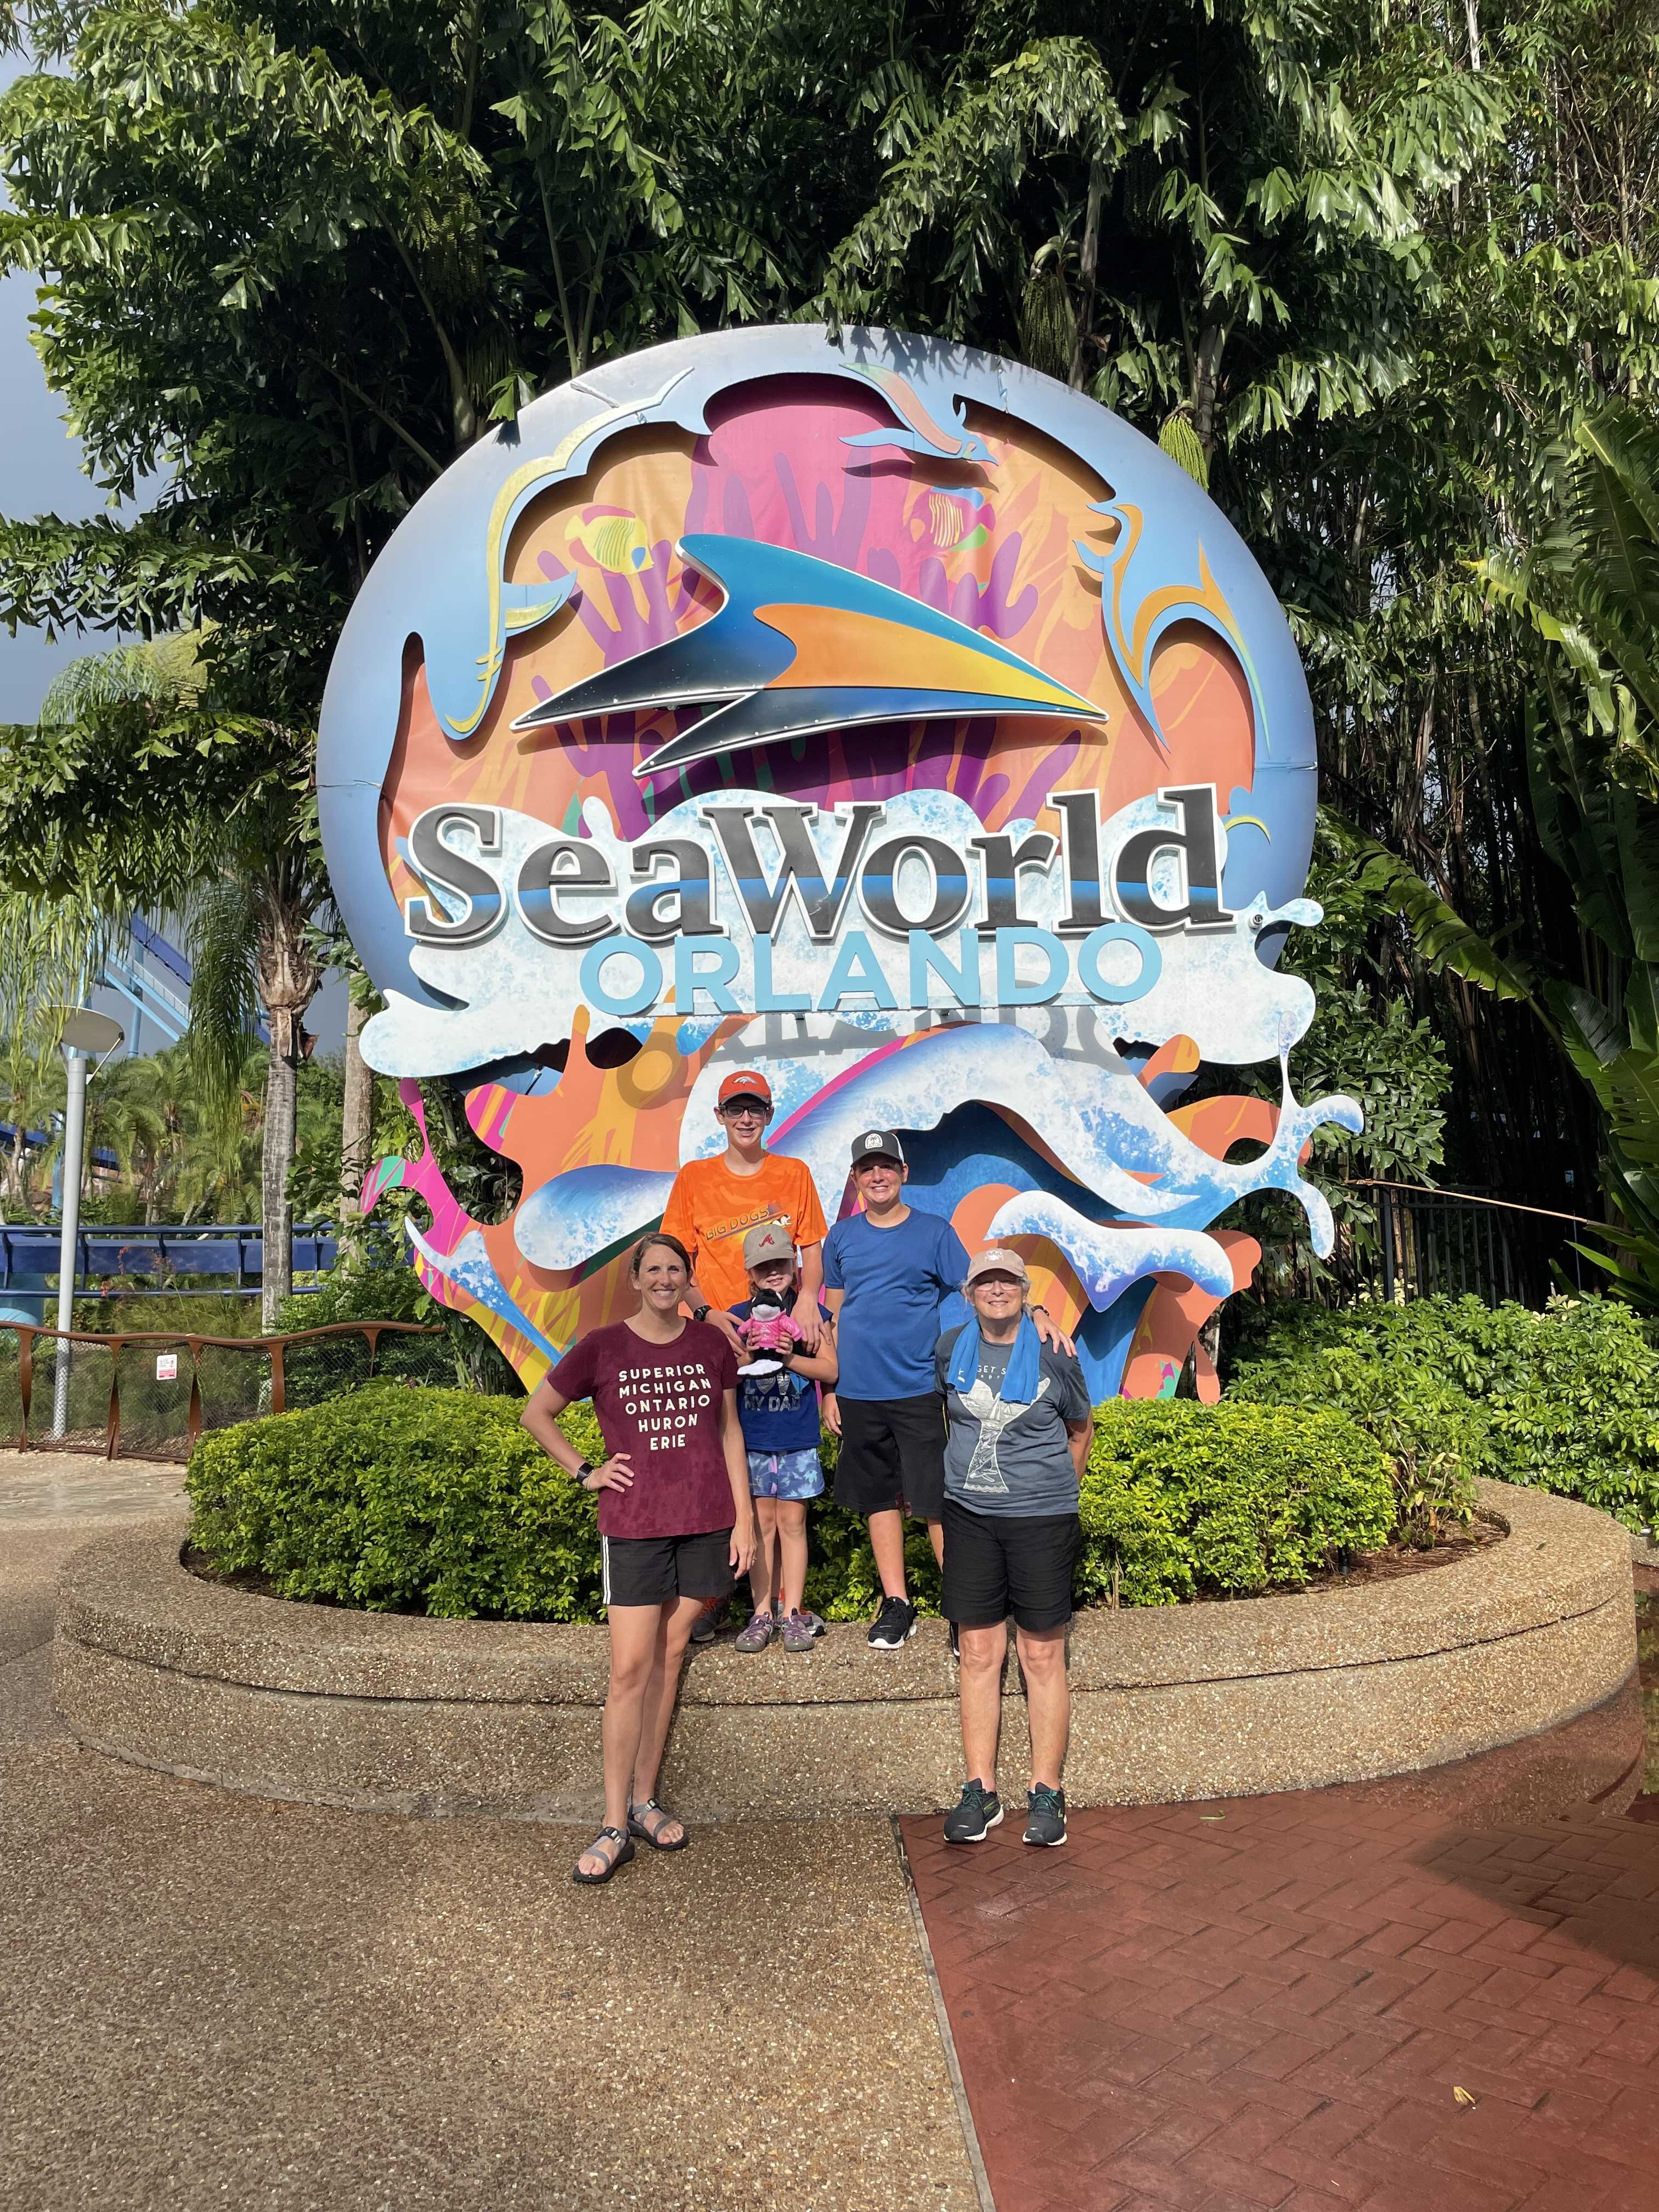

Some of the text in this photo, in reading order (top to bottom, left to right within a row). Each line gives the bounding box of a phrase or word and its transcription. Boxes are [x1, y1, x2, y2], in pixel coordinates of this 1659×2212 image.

[405, 782, 1238, 945] SeaWorld
[580, 923, 1163, 1016] ORLANDO
[706, 1205, 769, 1240] BIG DOGS
[619, 1364, 706, 1382] SUPERIOR
[619, 1378, 712, 1399] MICHIGAN
[625, 1395, 710, 1415] ONTARIO
[744, 1394, 801, 1412] MY DAD
[638, 1413, 698, 1432] HURON
[650, 1434, 686, 1451] ERIE
